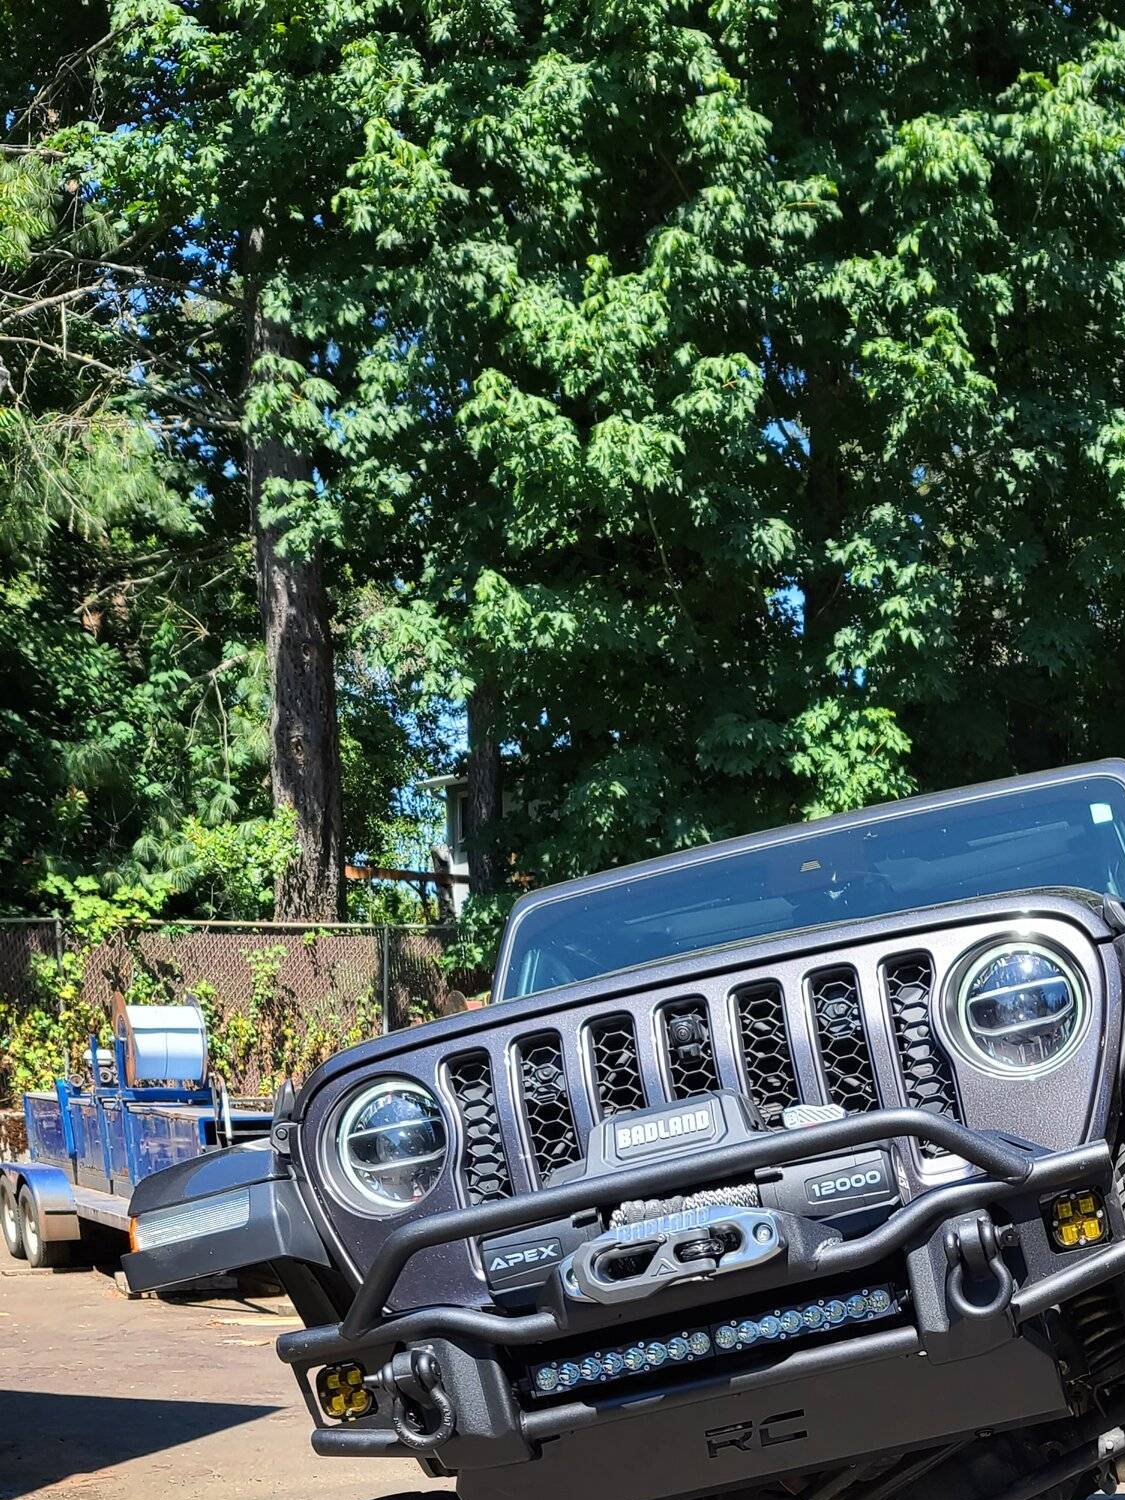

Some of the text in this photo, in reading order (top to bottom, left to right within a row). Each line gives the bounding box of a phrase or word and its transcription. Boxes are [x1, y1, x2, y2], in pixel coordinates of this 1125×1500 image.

[617, 1110, 710, 1150] BADLAND
[811, 1170, 881, 1197] 12000
[490, 1243, 558, 1271] APEX
[705, 1408, 808, 1459] RC
